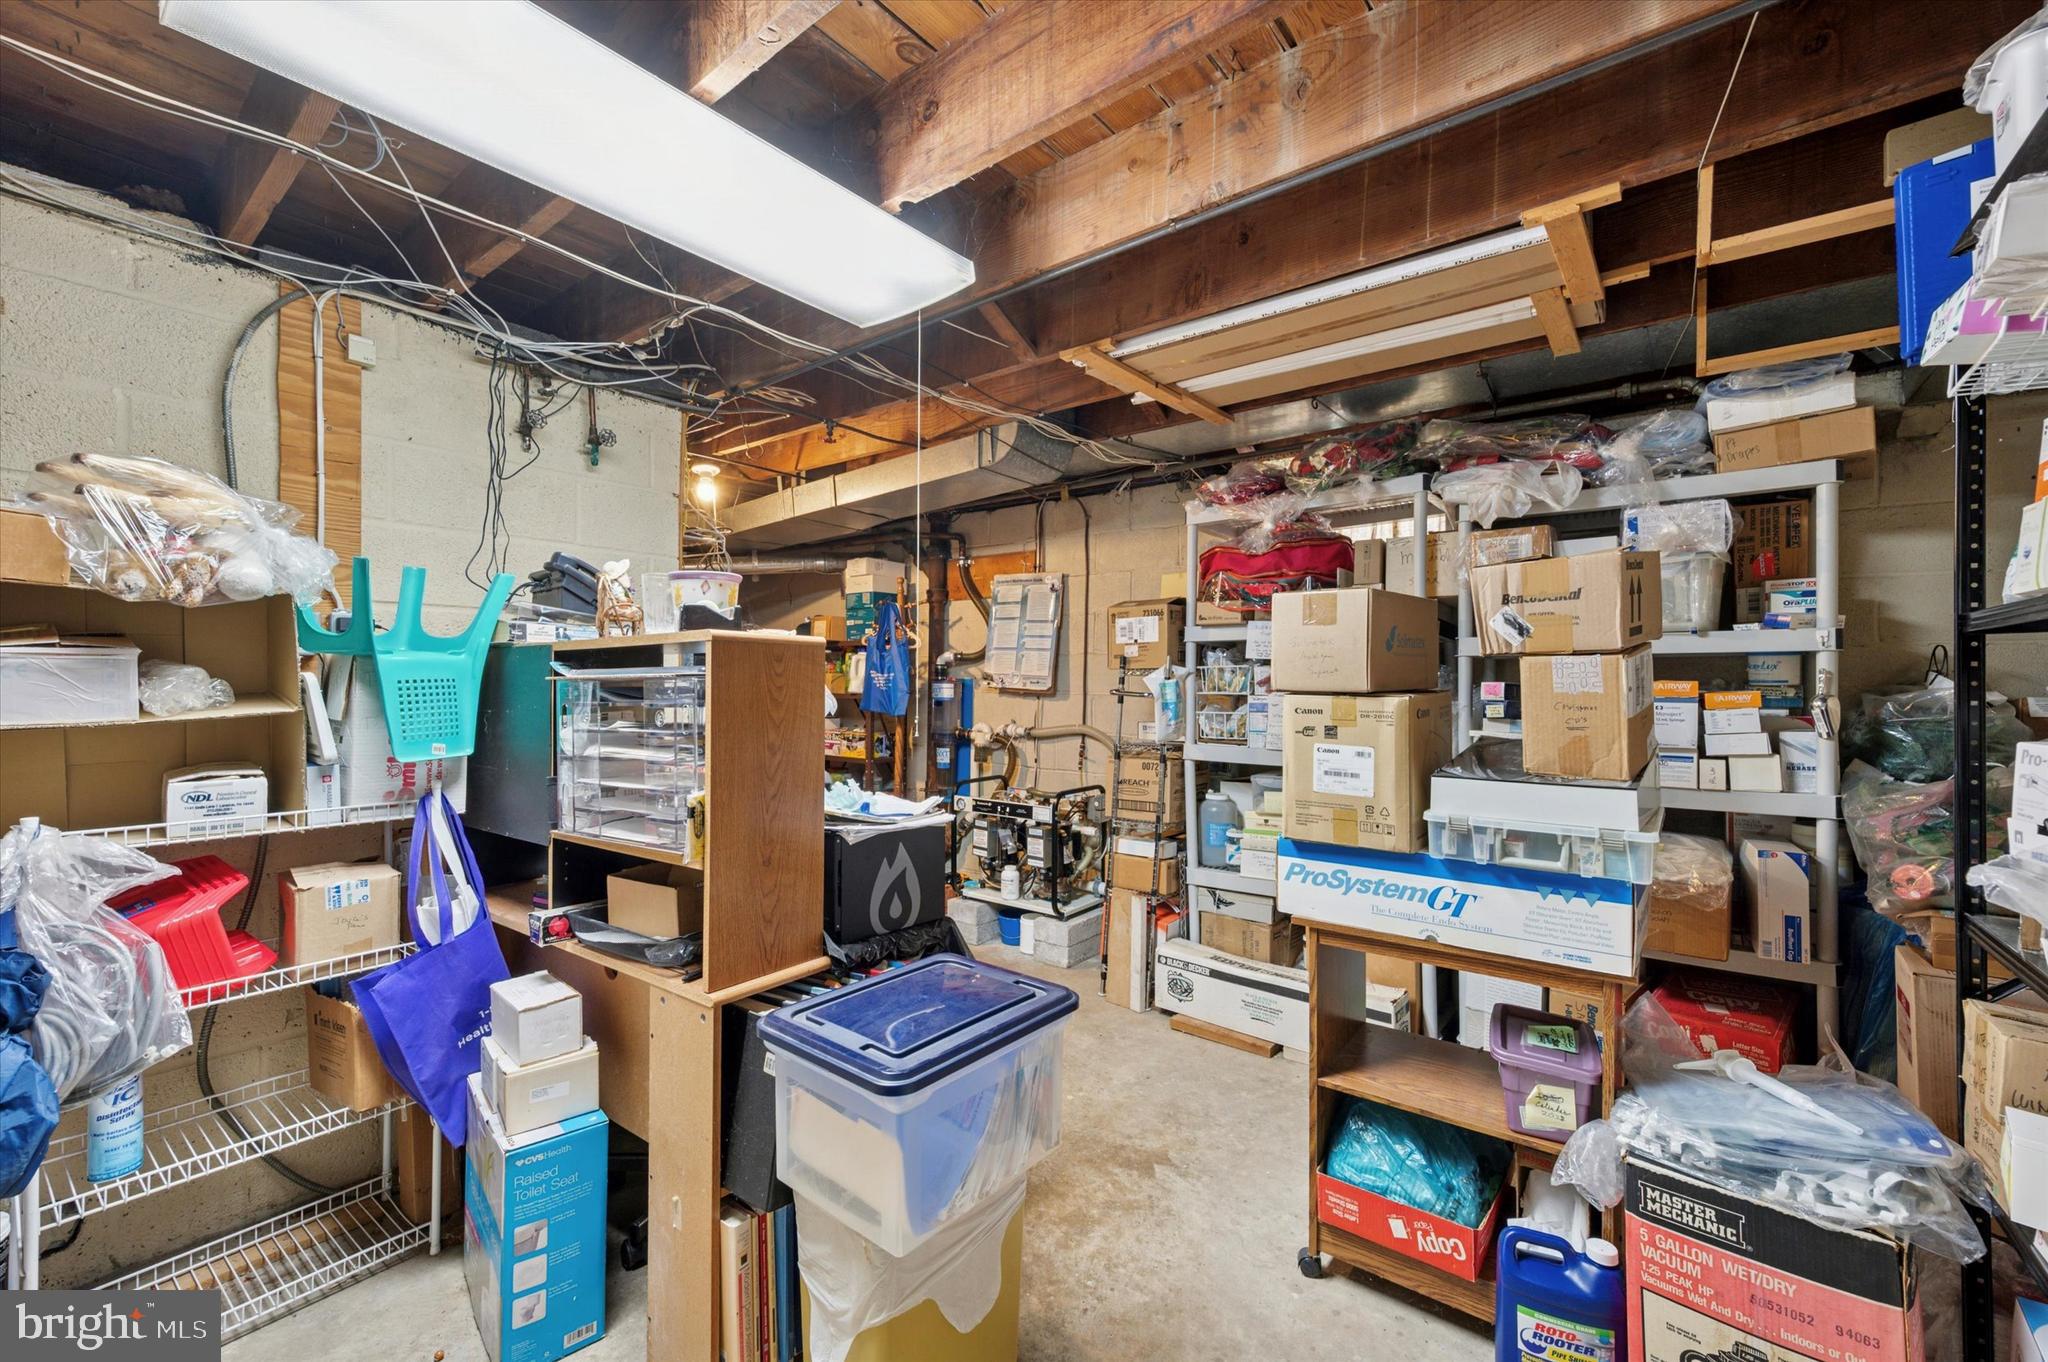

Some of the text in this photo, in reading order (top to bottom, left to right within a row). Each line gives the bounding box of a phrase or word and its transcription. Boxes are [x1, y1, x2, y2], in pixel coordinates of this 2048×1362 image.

[1783, 599, 1816, 607] OraPLU
[1294, 707, 1324, 716] Canon
[1317, 747, 1340, 755] Canon
[2020, 749, 2048, 767] Pro-
[186, 794, 213, 803] NDL
[1284, 862, 1478, 918] ProSystemGT
[1371, 904, 1494, 933] The Complete Endo System
[478, 1006, 492, 1019] 1-
[109, 1109, 136, 1125] Spray
[513, 1184, 546, 1202] Toilet
[550, 1171, 579, 1191] Seat
[514, 1165, 559, 1188] Raised
[1646, 1187, 1718, 1222] MASTER
[1646, 1199, 1737, 1242] MECHANIC
[1416, 1230, 1467, 1262] Copy
[1639, 1227, 1798, 1299] 5 GALLON WET/DRY
[1640, 1242, 1702, 1280] VACUUM
[1641, 1261, 1715, 1297] 1.25 PEAK HP
[1640, 1270, 1685, 1298] Vacuums
[1687, 1290, 1708, 1307] Wet
[1710, 1301, 1732, 1318] And
[1735, 1308, 1755, 1330] Dry
[1780, 1328, 1826, 1355] Indoors
[1828, 1346, 1841, 1360] or
[1532, 1331, 1596, 1357] ROOTER
[1835, 1325, 1881, 1350] 94063
